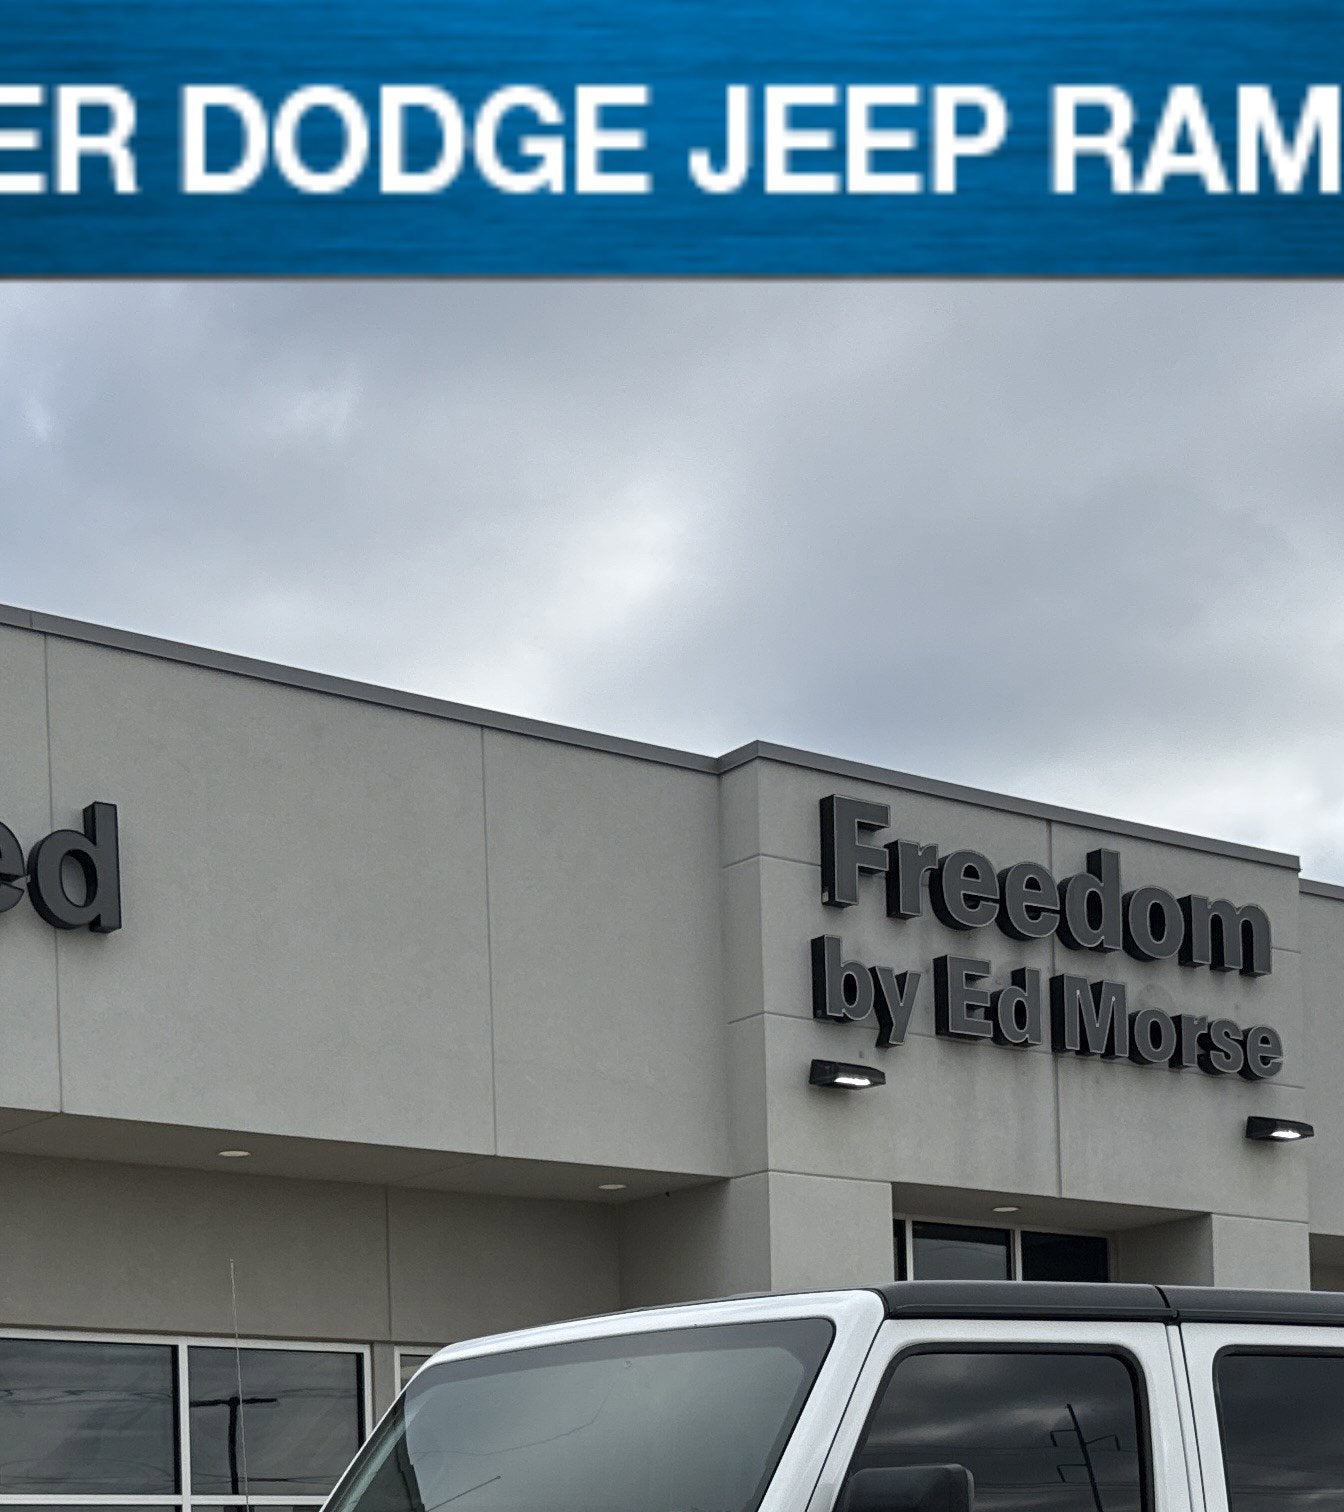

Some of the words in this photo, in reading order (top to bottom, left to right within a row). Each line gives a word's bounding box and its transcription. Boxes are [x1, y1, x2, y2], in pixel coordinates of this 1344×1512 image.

[819, 793, 1273, 977] Freedom
[811, 934, 922, 1048] by
[933, 954, 1043, 1047] Ed
[1049, 973, 1284, 1080] Morse
